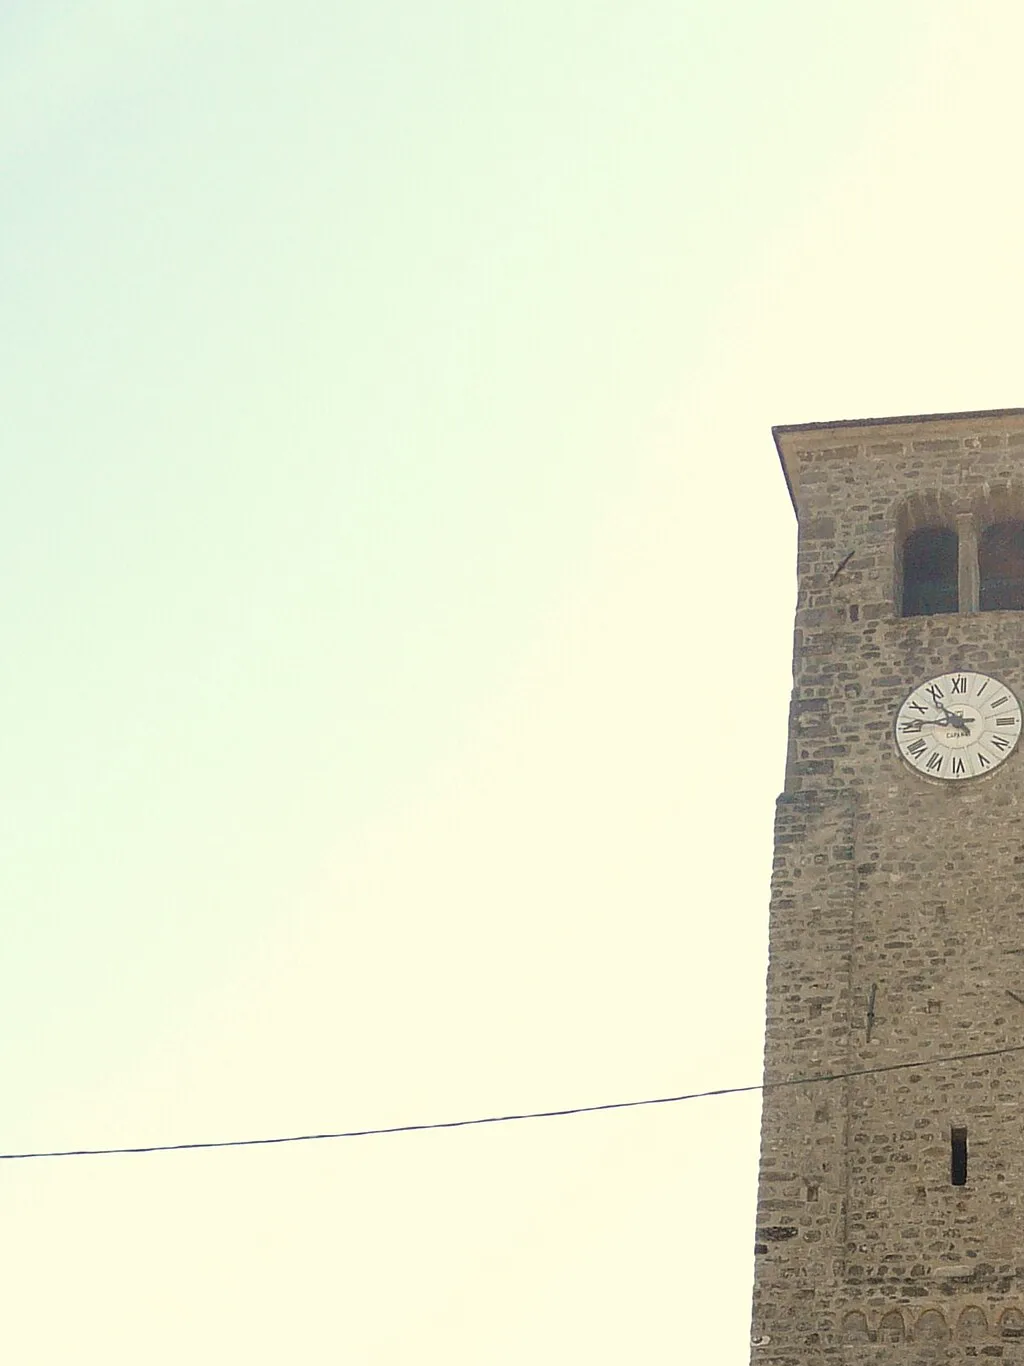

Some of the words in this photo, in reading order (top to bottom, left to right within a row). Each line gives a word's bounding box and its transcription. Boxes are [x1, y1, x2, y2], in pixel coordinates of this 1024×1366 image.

[926, 684, 944, 699] XI
[951, 677, 967, 693] XII
[908, 701, 928, 715] X
[991, 696, 1009, 708] II
[996, 717, 1015, 726] III
[907, 738, 928, 760] VIII
[991, 735, 1010, 751] IV
[926, 752, 944, 772] VII
[952, 757, 965, 774] VI
[977, 753, 990, 767] V
